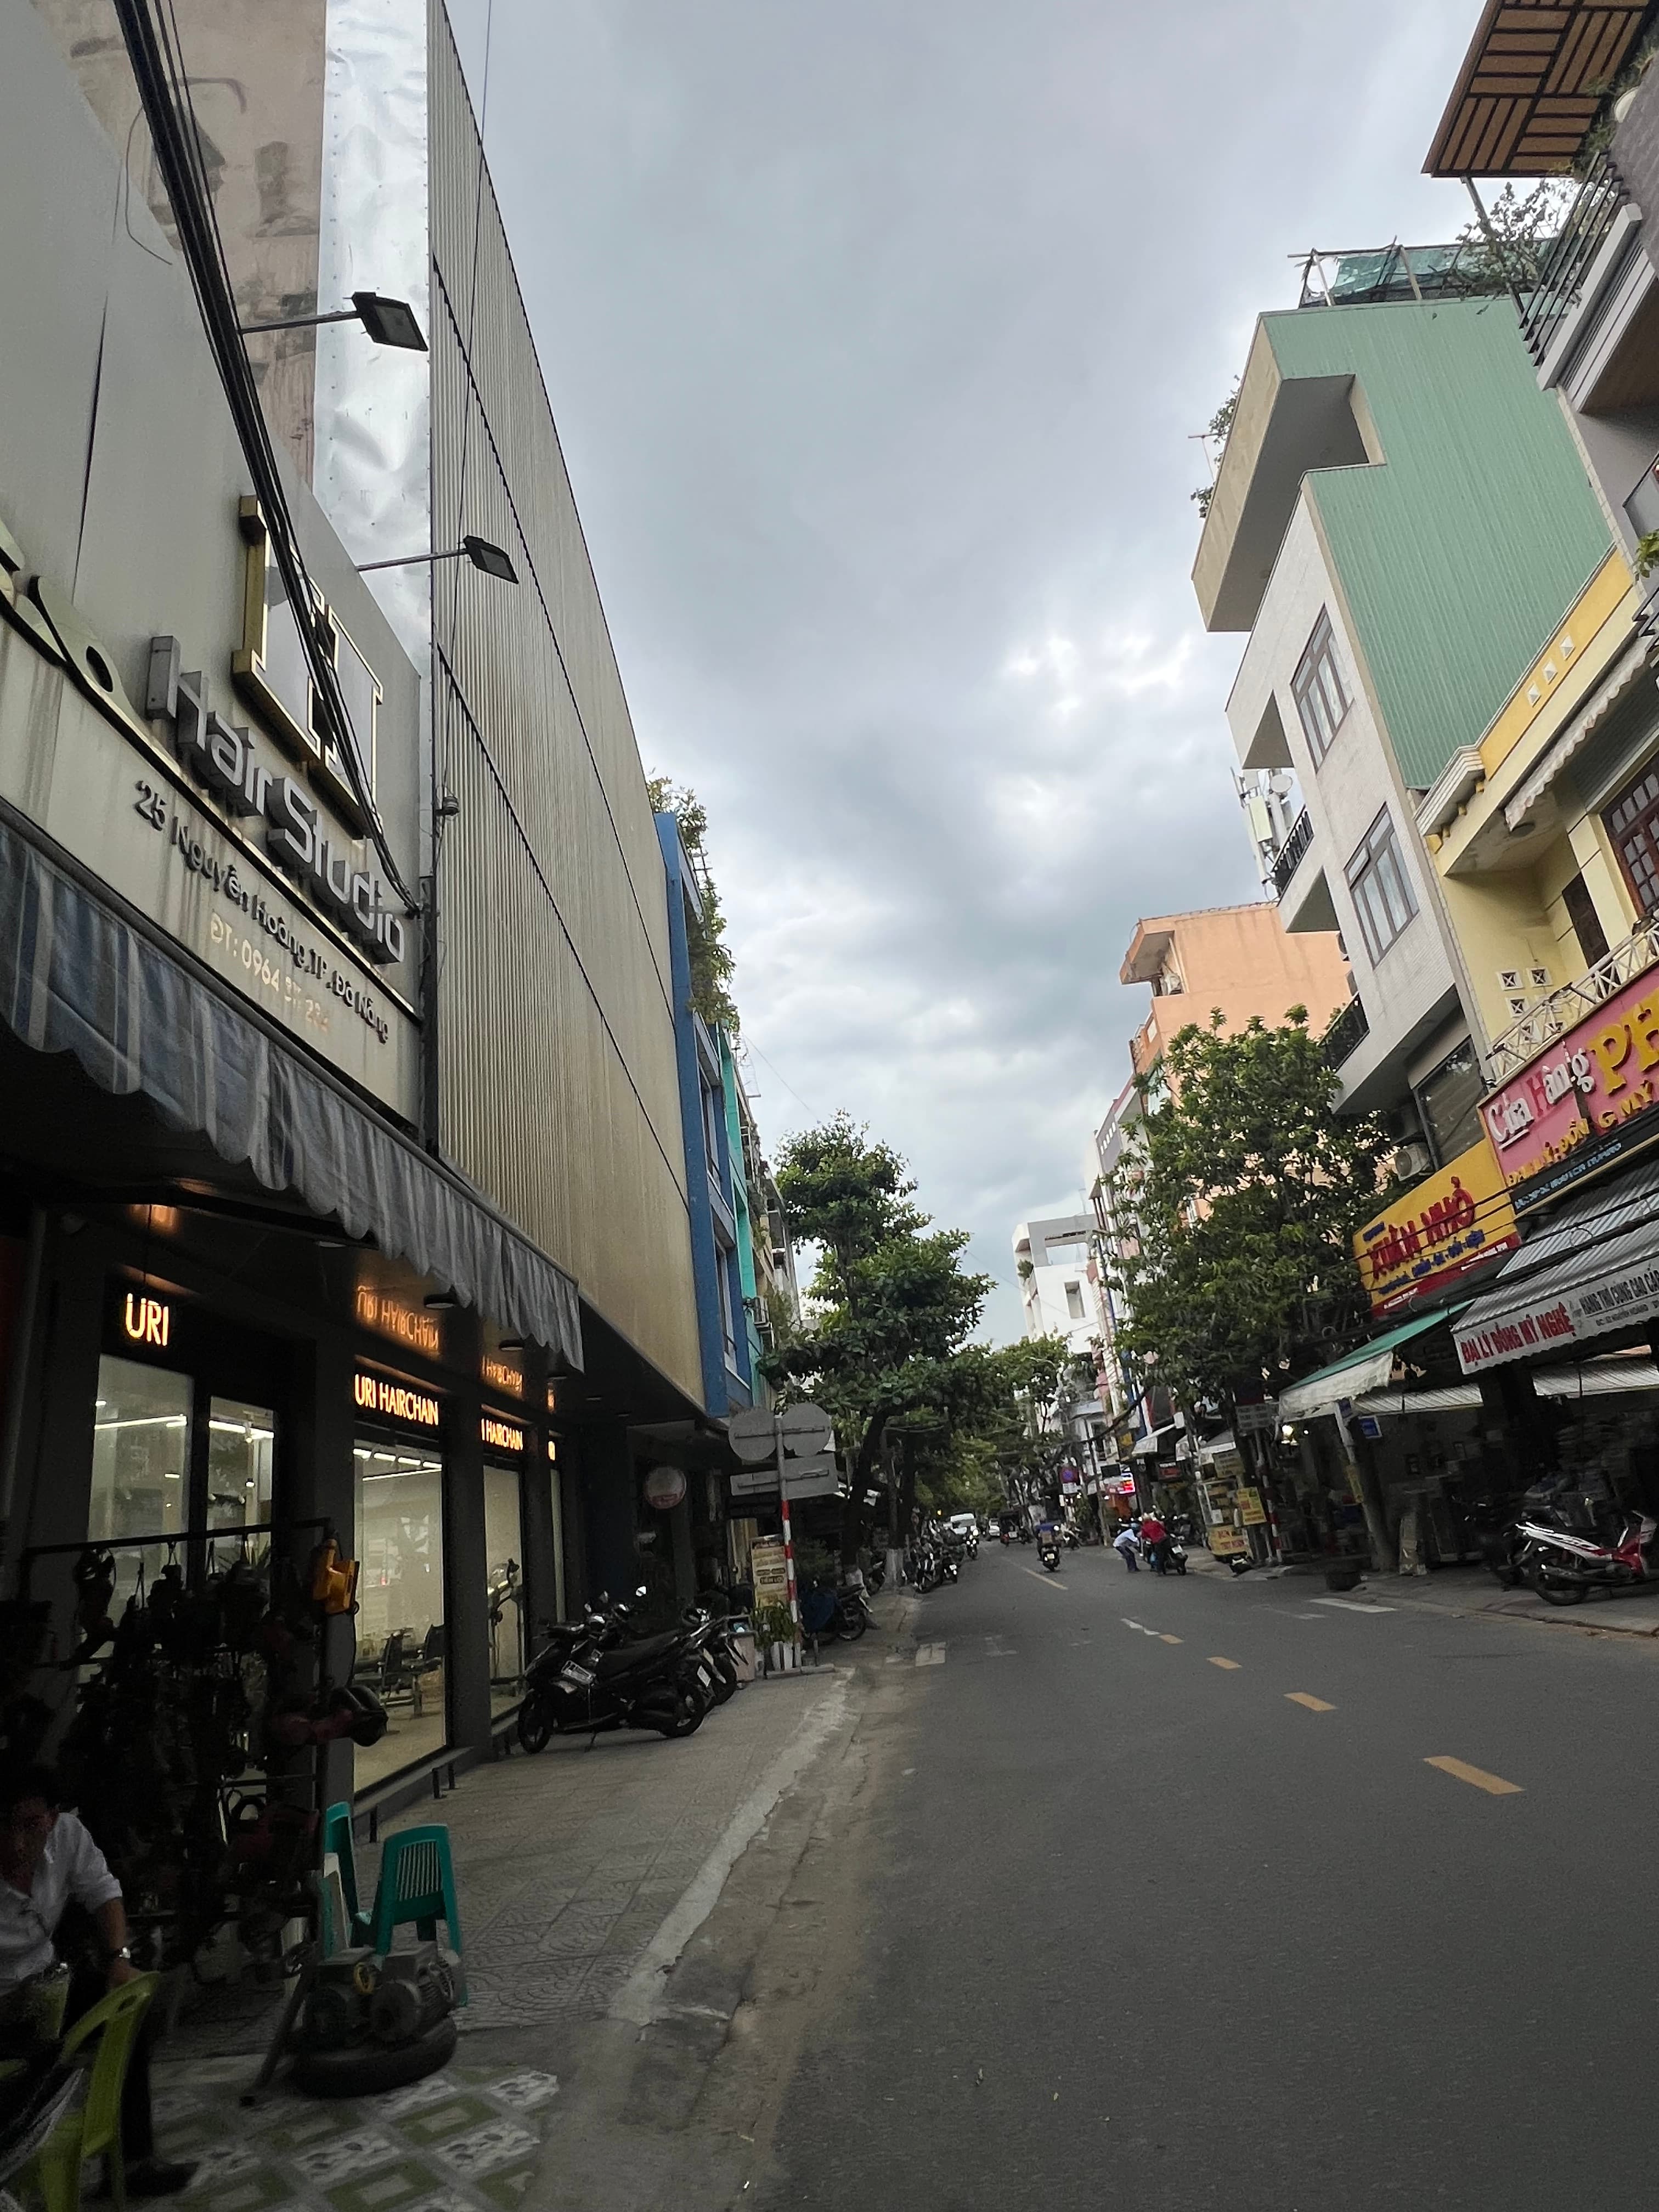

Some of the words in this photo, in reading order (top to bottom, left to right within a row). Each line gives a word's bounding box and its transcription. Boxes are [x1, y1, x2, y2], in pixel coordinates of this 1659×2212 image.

[134, 780, 167, 832] 25
[148, 636, 273, 817] Hair
[268, 777, 404, 963] Studio
[241, 939, 280, 992] 0964
[126, 1293, 169, 1346] URI
[354, 1374, 376, 1409] URI
[379, 1382, 439, 1426] HAIRCHAIN
[486, 1419, 523, 1451] HAIRCHAIN
